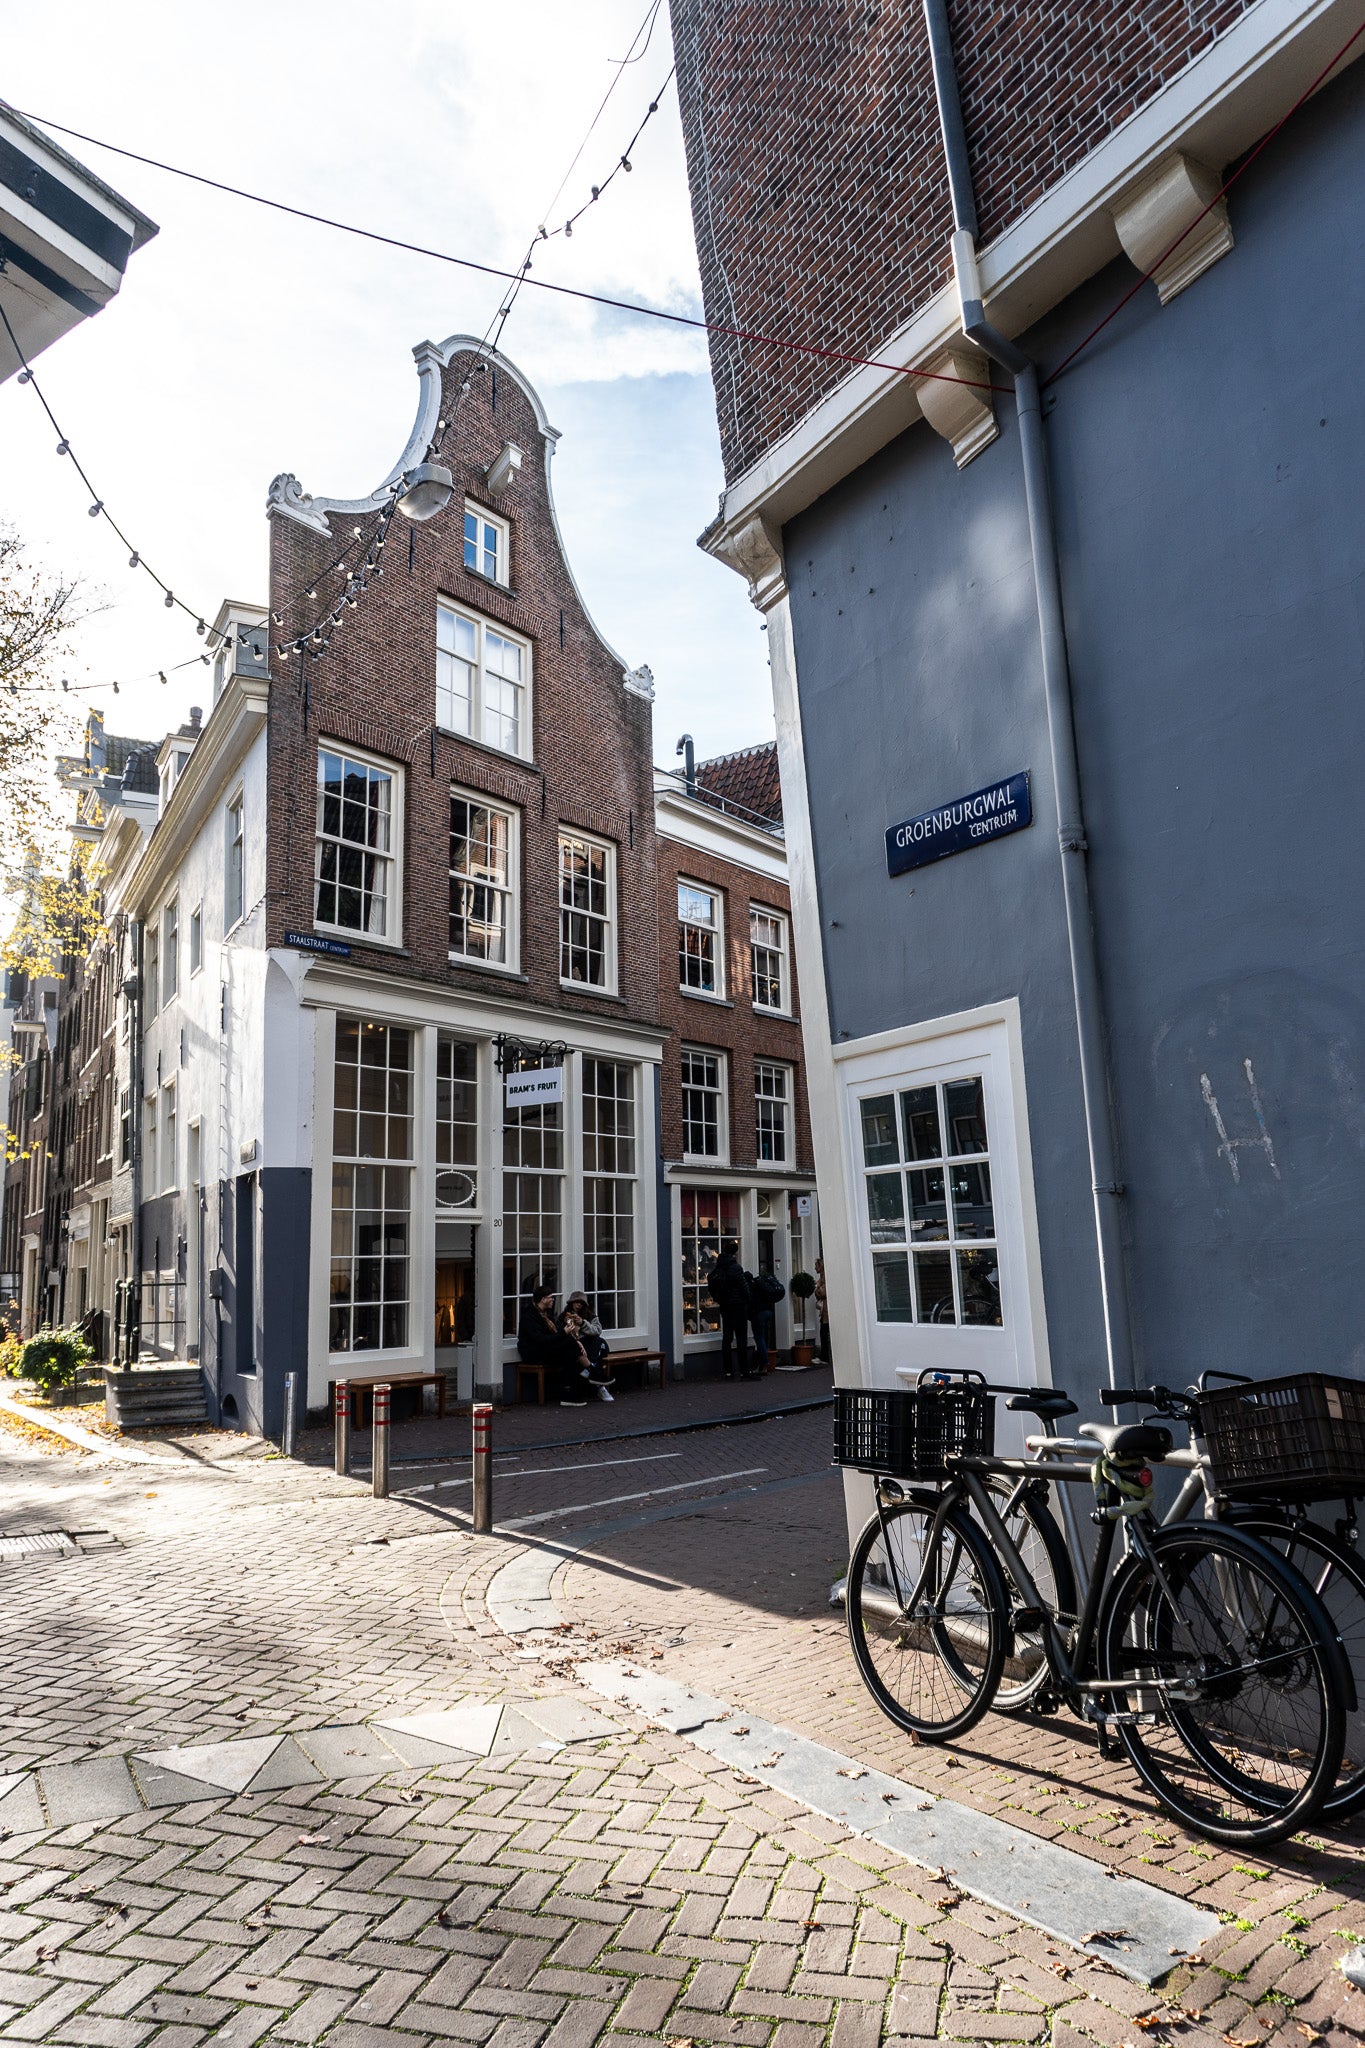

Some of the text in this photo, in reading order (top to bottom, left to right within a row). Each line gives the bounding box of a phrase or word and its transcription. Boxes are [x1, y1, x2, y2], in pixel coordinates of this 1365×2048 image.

[896, 785, 1015, 847] GROENBURGWAL
[969, 809, 1017, 838] CENTRUM
[289, 934, 329, 950] STAALSTRAAT
[509, 1081, 558, 1095] BRAM'S FRUIT
[493, 1218, 503, 1228] 20
